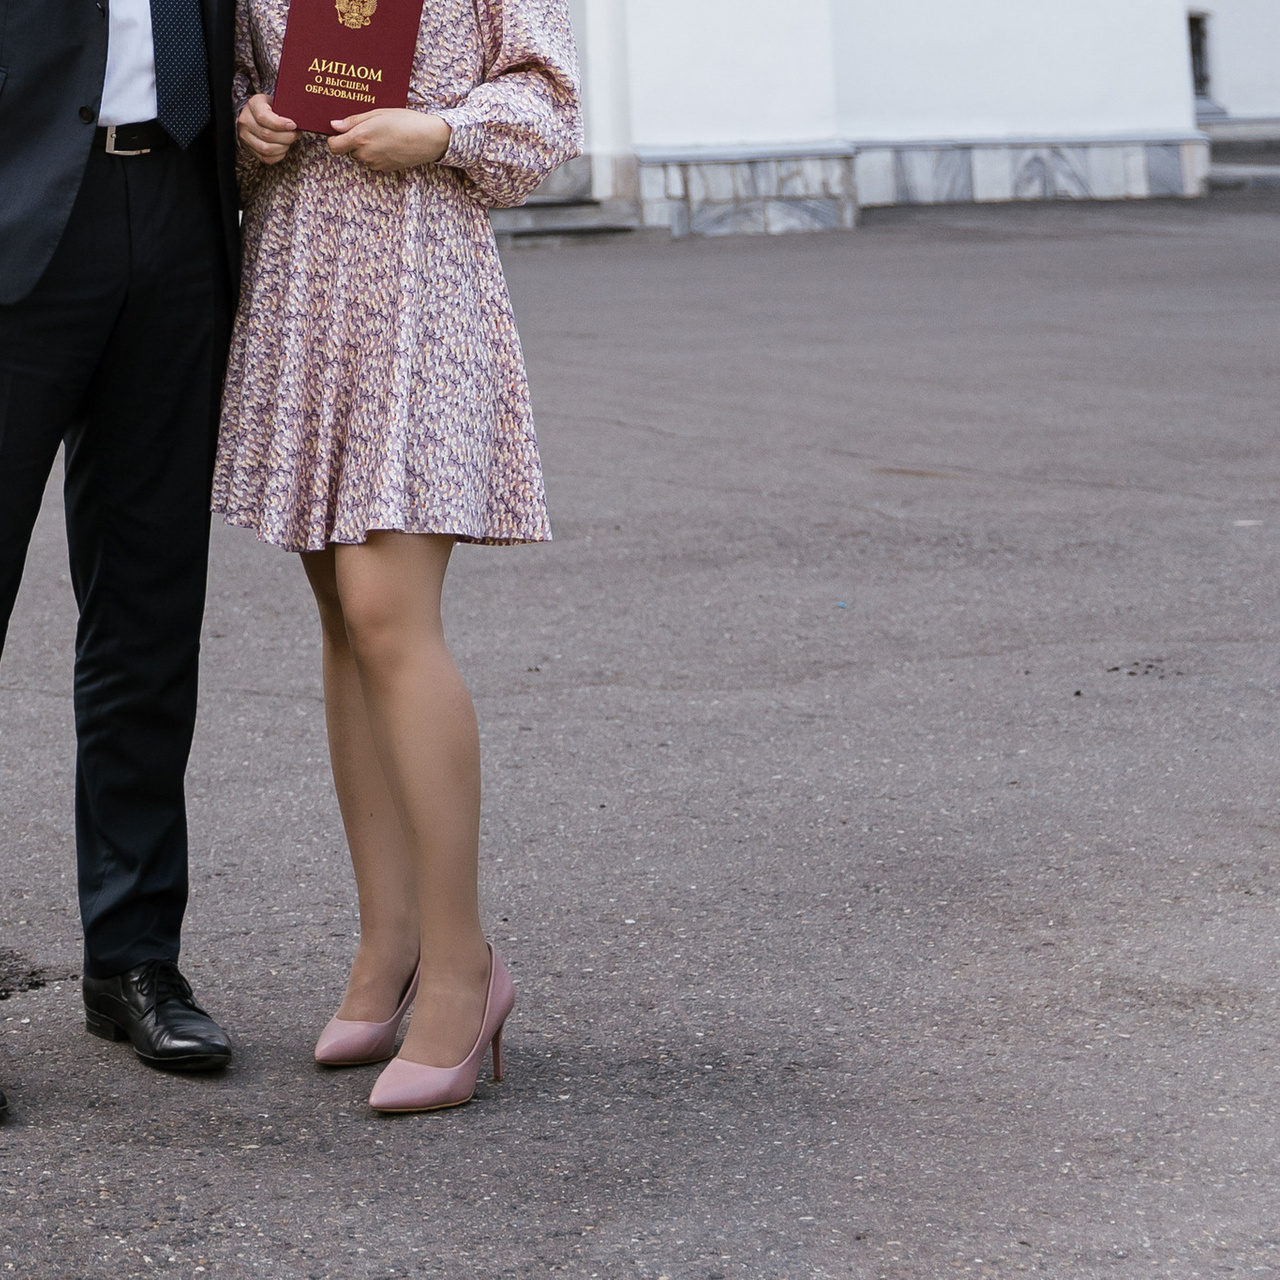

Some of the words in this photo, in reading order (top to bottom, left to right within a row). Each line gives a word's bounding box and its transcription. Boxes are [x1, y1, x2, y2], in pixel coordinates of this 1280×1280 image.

[307, 57, 383, 82] ДИПЛОМ
[304, 83, 376, 104] ОБРАЗОВАНИИ
[314, 74, 323, 84] О
[325, 76, 370, 92] ВЫСШЕМ
